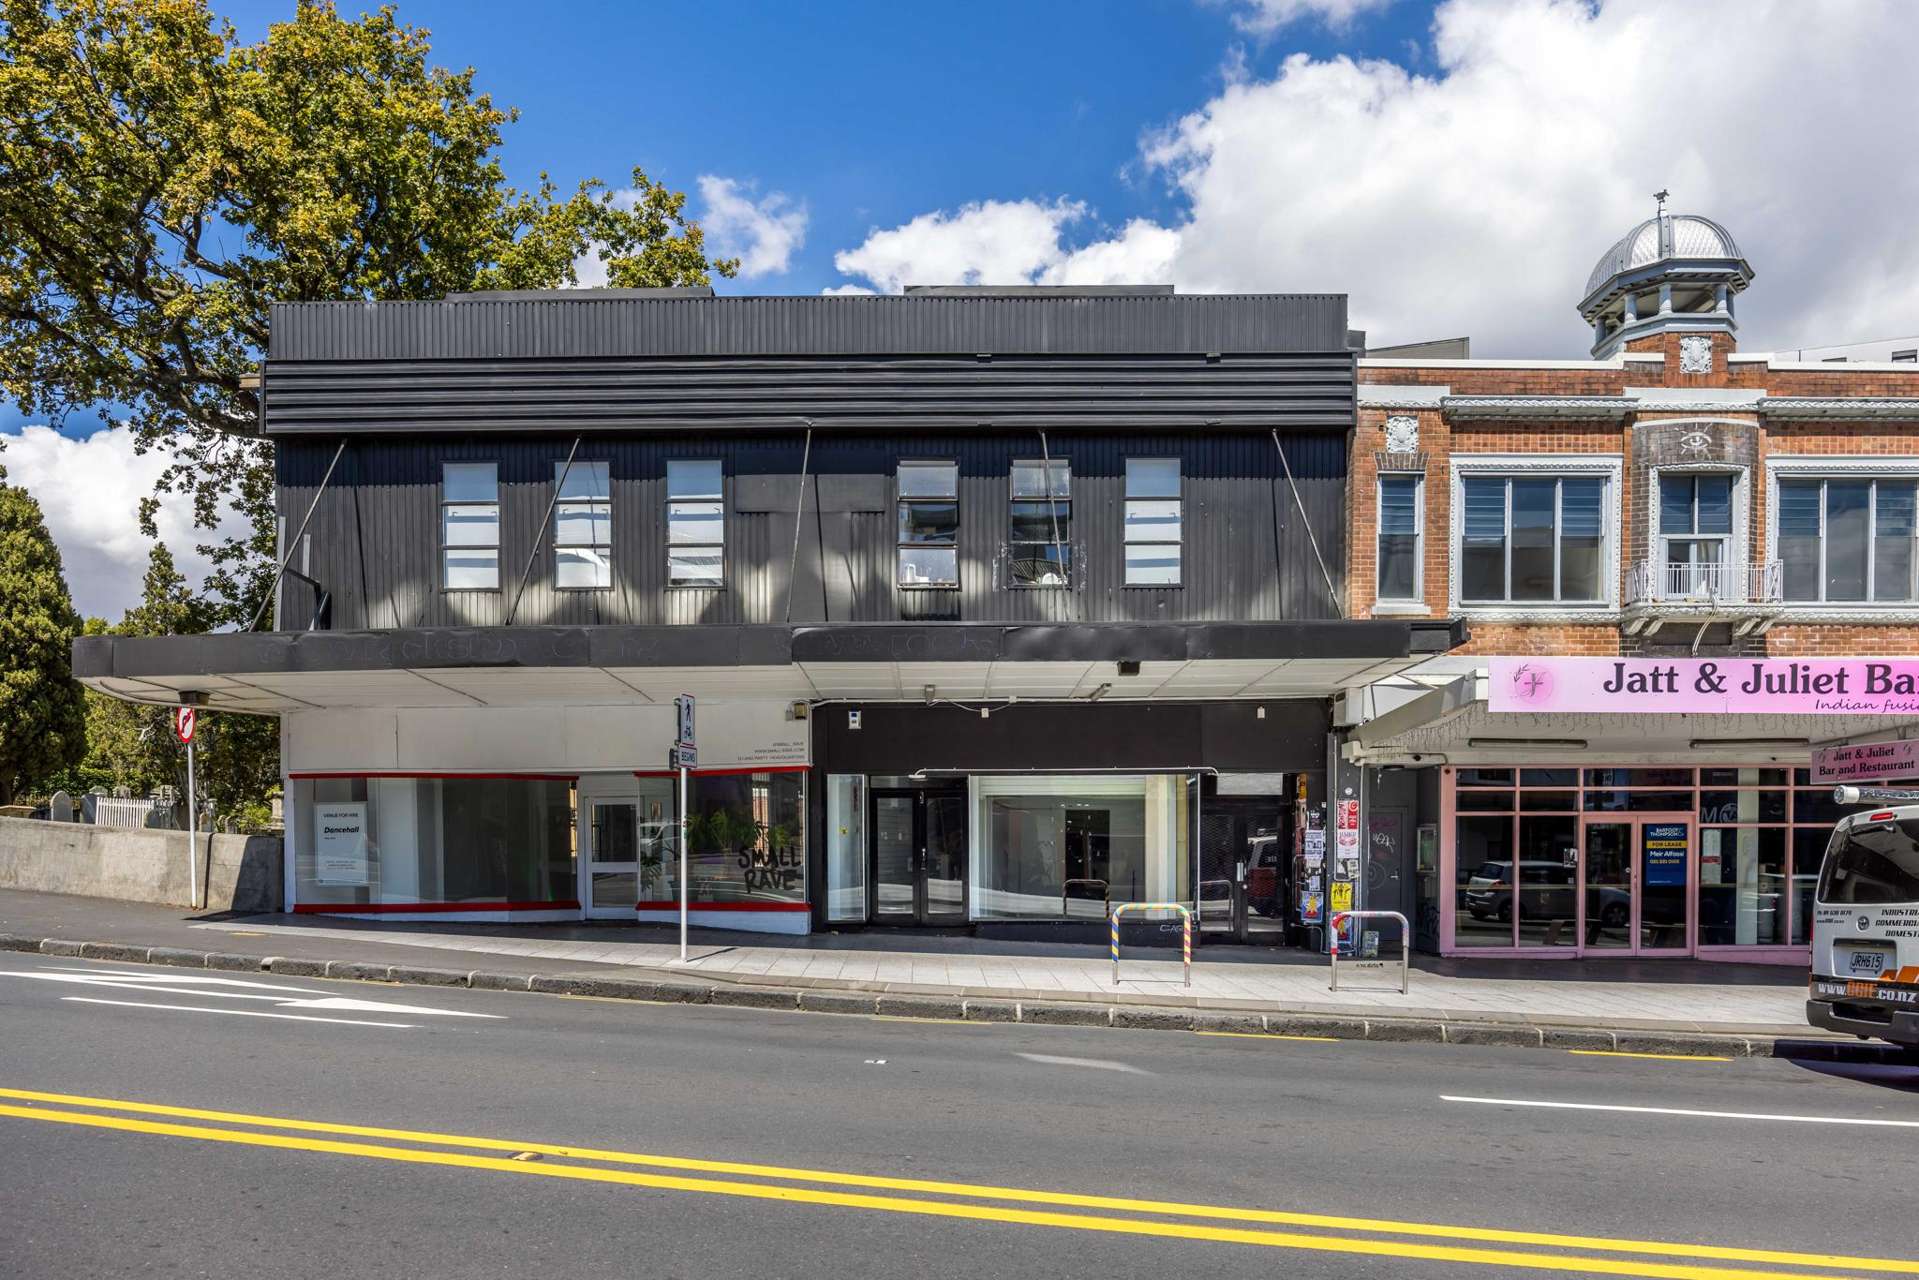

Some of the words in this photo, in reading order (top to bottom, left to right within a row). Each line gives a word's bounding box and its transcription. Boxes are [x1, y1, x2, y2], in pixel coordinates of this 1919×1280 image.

[1603, 662, 1679, 693] Jatt
[1694, 662, 1727, 694] &
[1741, 663, 1850, 694] Juliet
[1864, 664, 1919, 695] Ba
[1815, 699, 1879, 710] Indian
[681, 751, 695, 762] BEGINS
[1833, 751, 1852, 761] Jatt
[1854, 748, 1865, 759] &
[1866, 747, 1895, 758] Juliet
[1819, 765, 1835, 776] Bar
[1838, 763, 1856, 774] and
[1859, 760, 1915, 773] Restaurant
[738, 846, 801, 869] SMALL
[744, 868, 799, 893] RAVE
[1881, 908, 1919, 916] INDUSTRI
[1875, 919, 1919, 927] COMMERCI
[1851, 953, 1881, 968] JRH615
